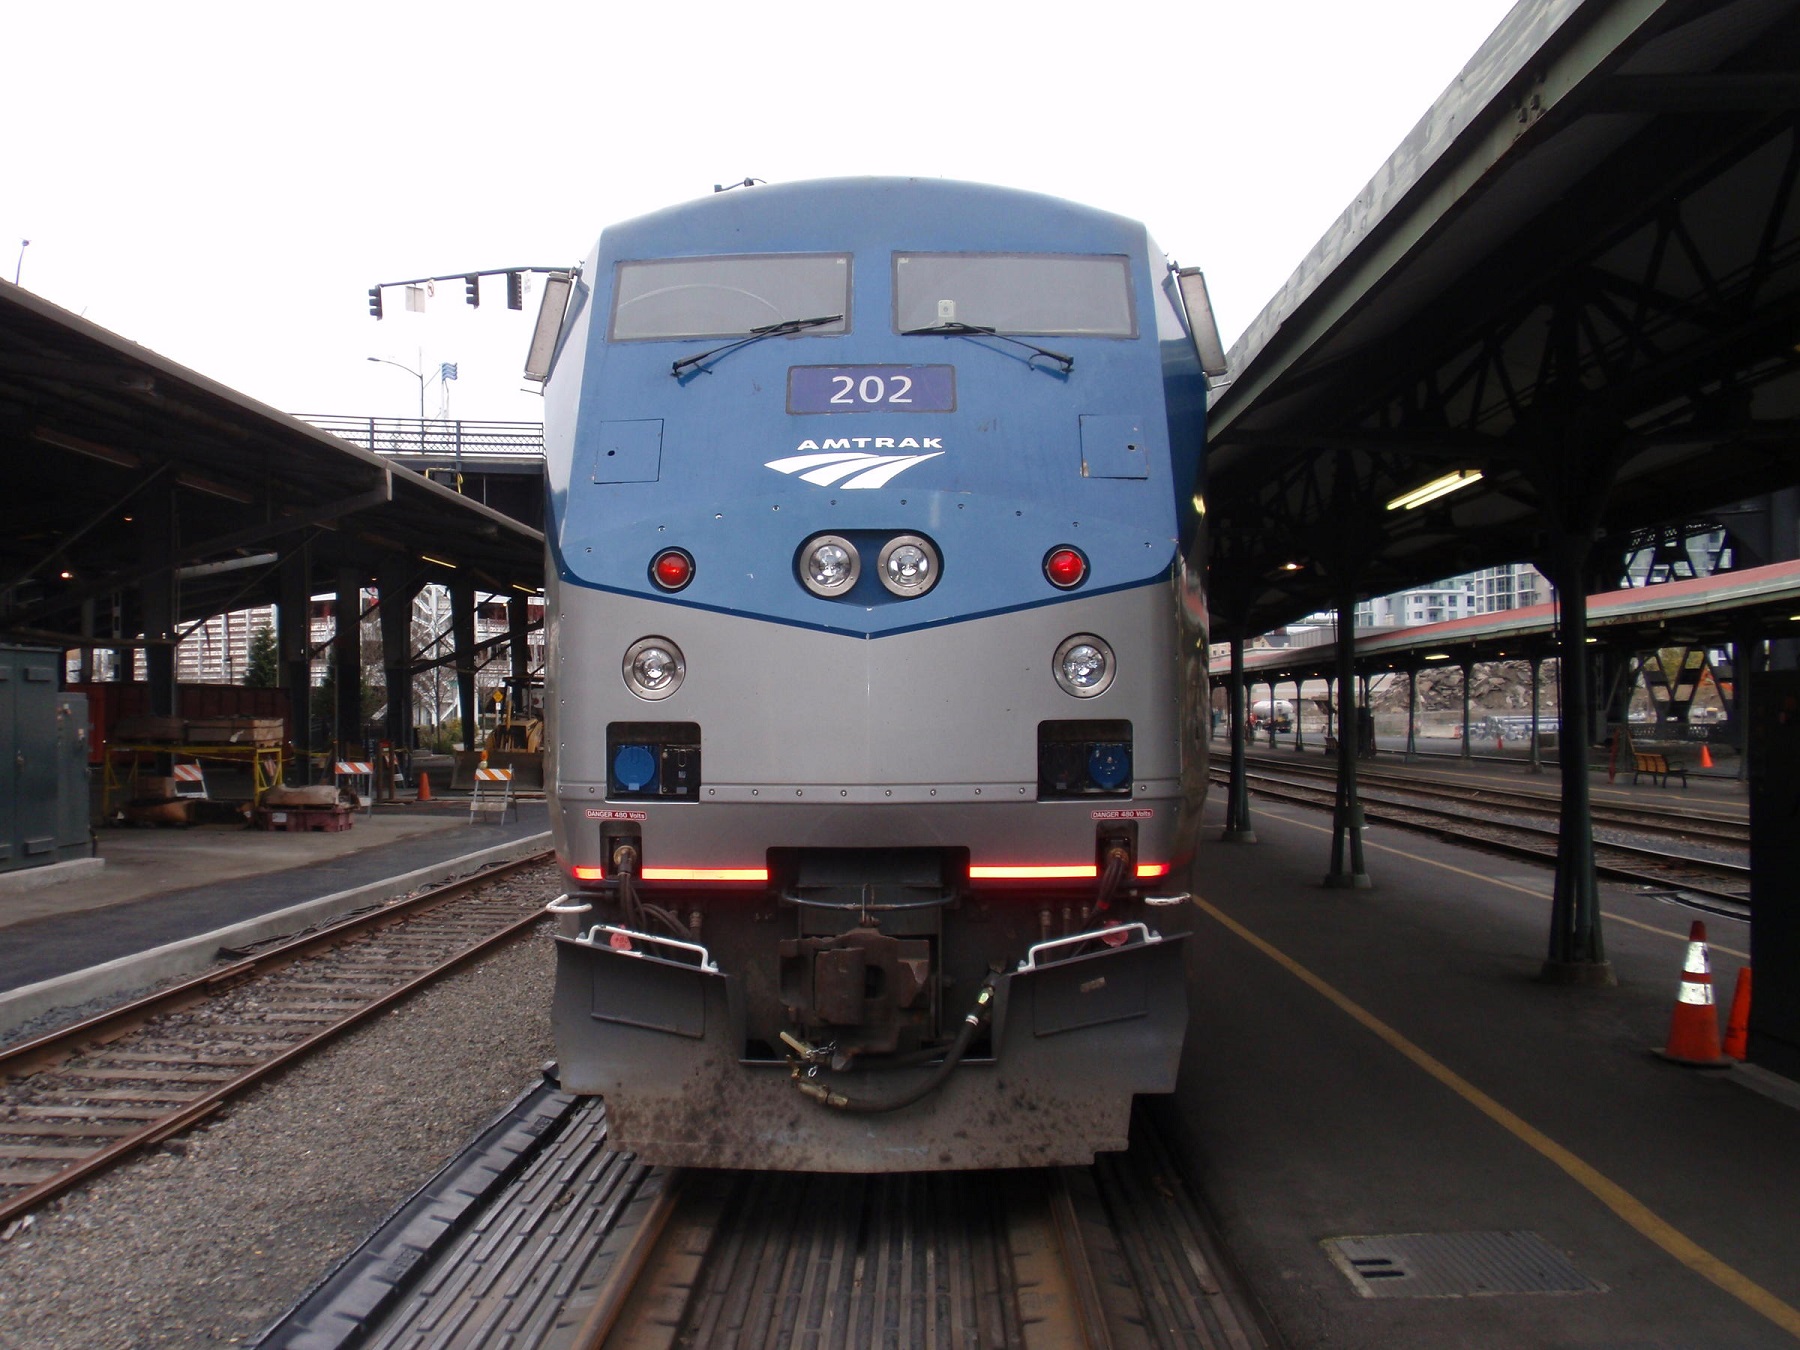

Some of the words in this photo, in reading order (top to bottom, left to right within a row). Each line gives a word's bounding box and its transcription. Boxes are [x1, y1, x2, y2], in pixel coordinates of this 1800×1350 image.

[830, 375, 913, 404] 202
[797, 437, 943, 451] AMTRAK
[1121, 810, 1134, 818] 480
